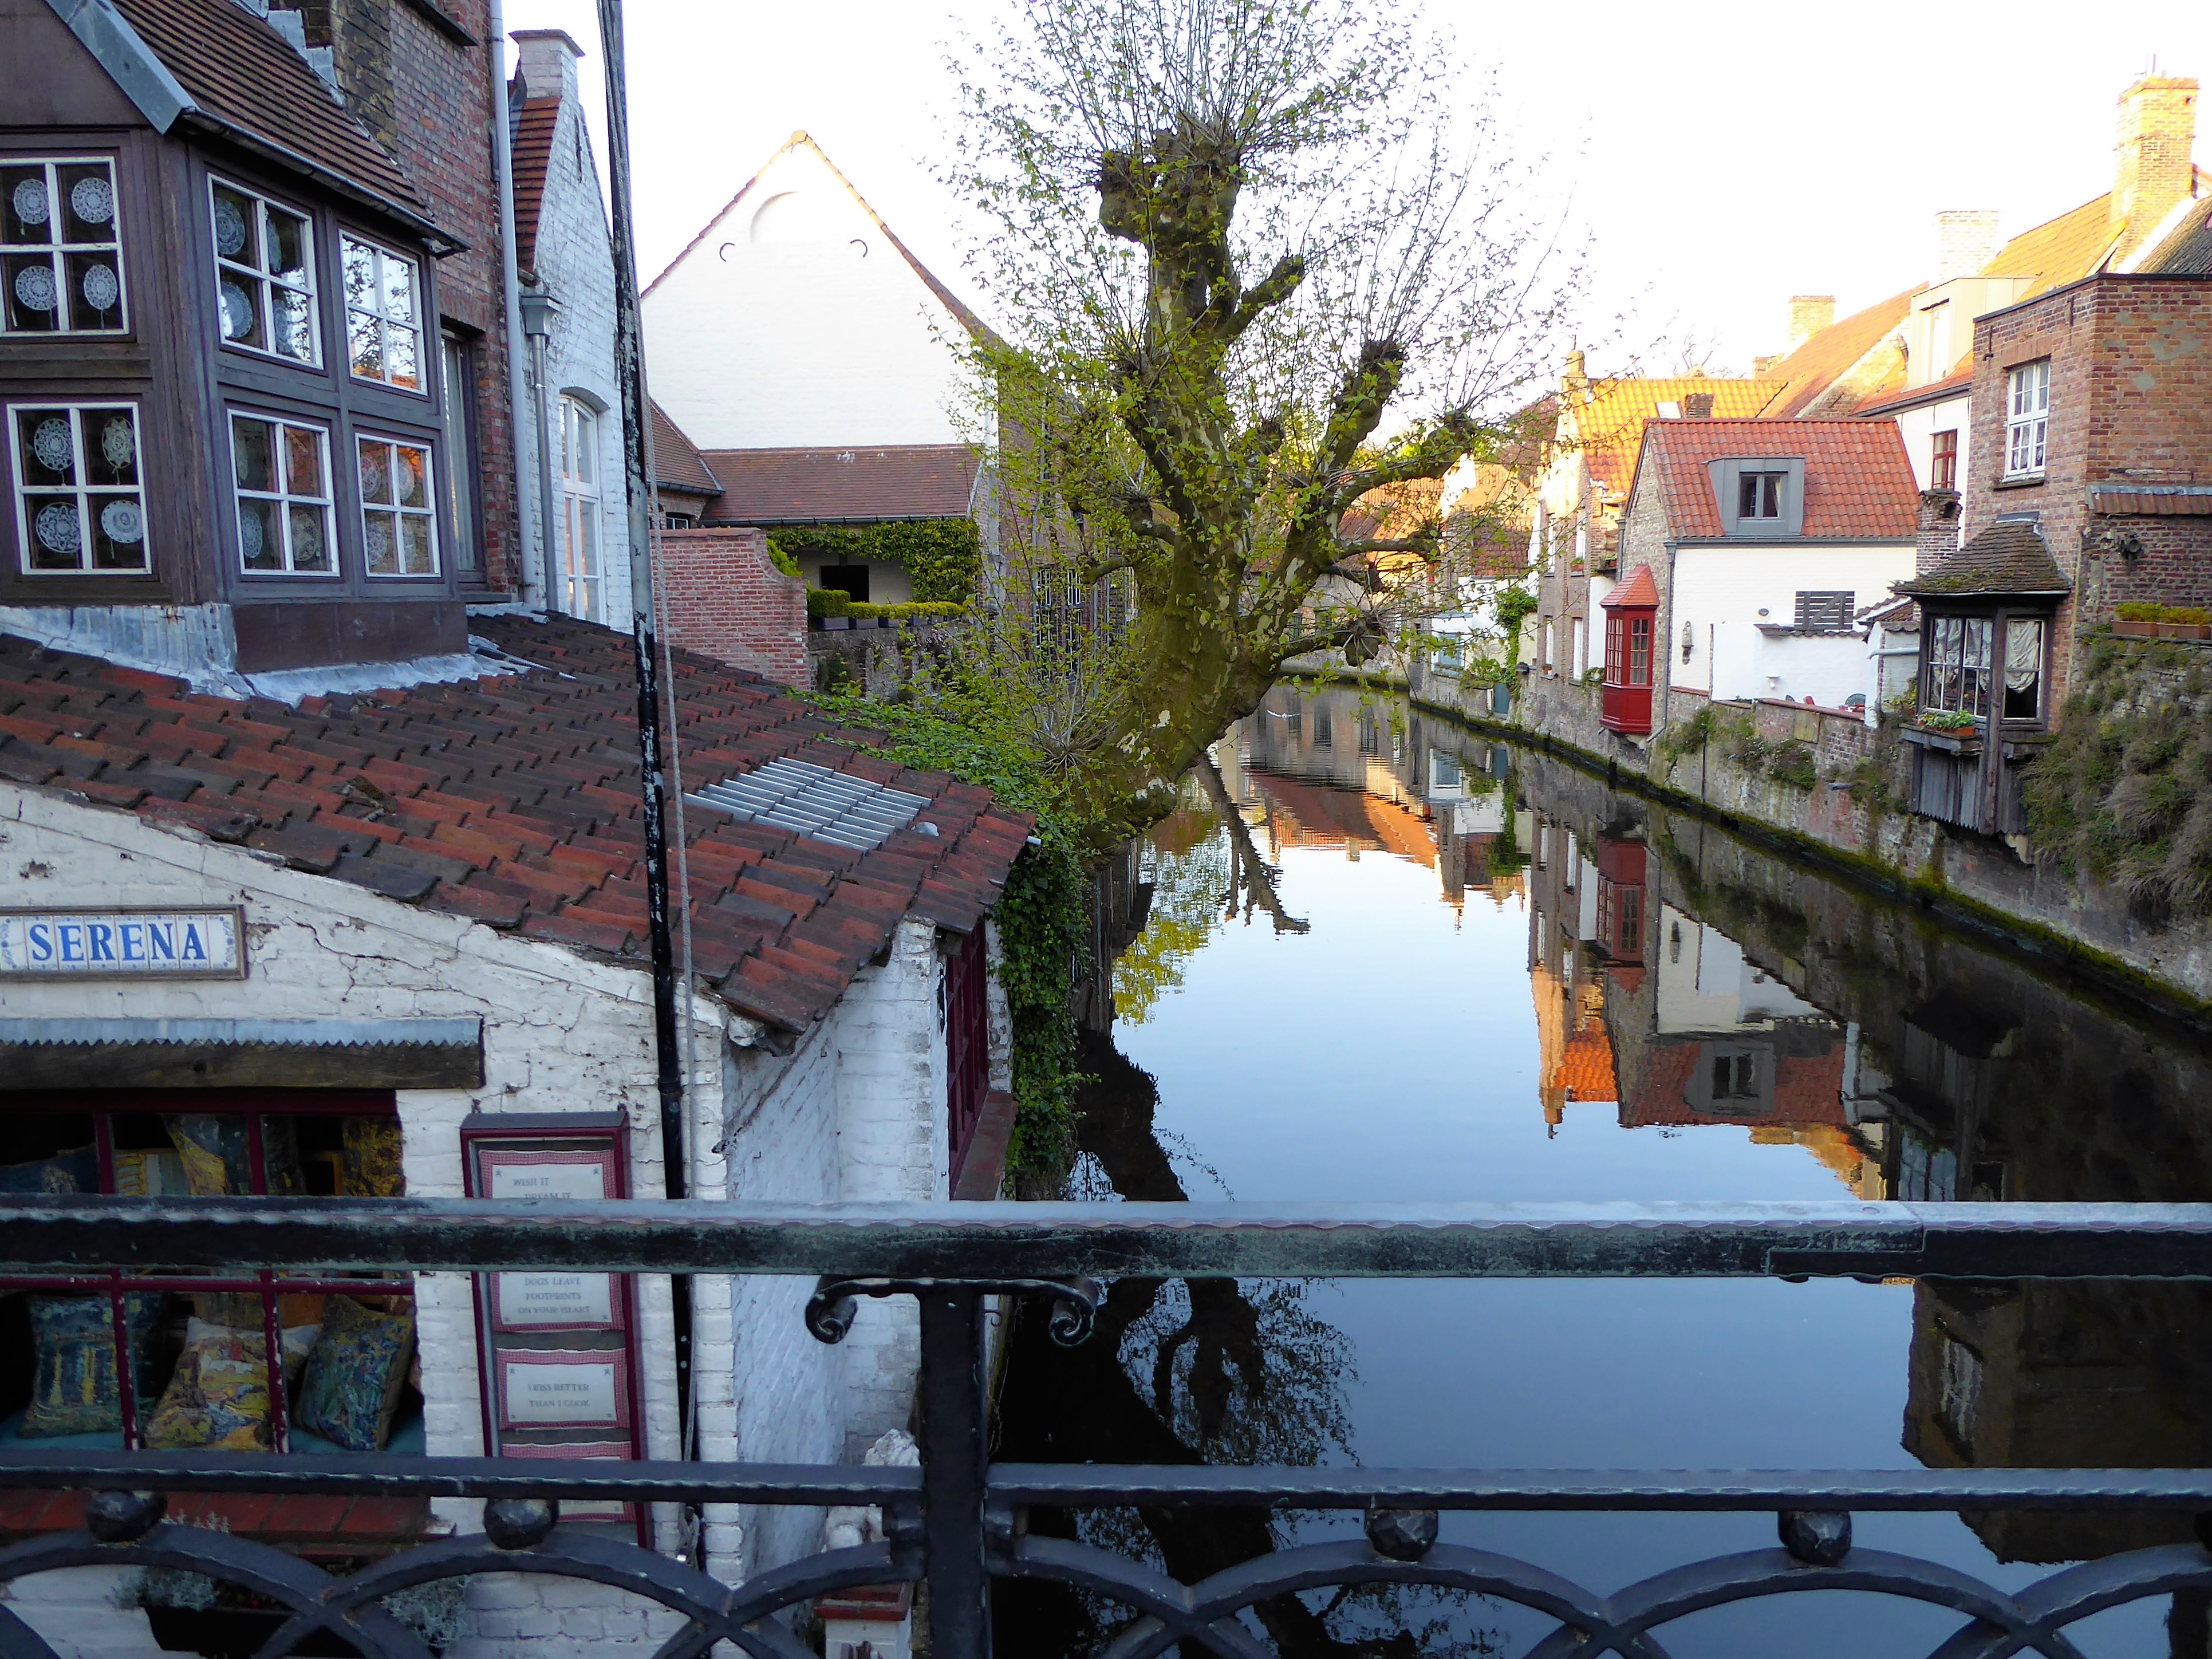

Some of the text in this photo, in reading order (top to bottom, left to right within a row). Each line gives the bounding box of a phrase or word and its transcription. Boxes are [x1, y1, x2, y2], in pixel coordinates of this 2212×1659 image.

[29, 923, 207, 961] SERENA
[513, 1177, 549, 1186] WISH IT
[525, 1276, 581, 1286] DOGS LEAVE
[526, 1292, 582, 1300] FOOTPRINTS
[561, 1306, 590, 1314] HEART
[533, 1384, 551, 1392] KISS
[554, 1383, 589, 1392] BETTER
